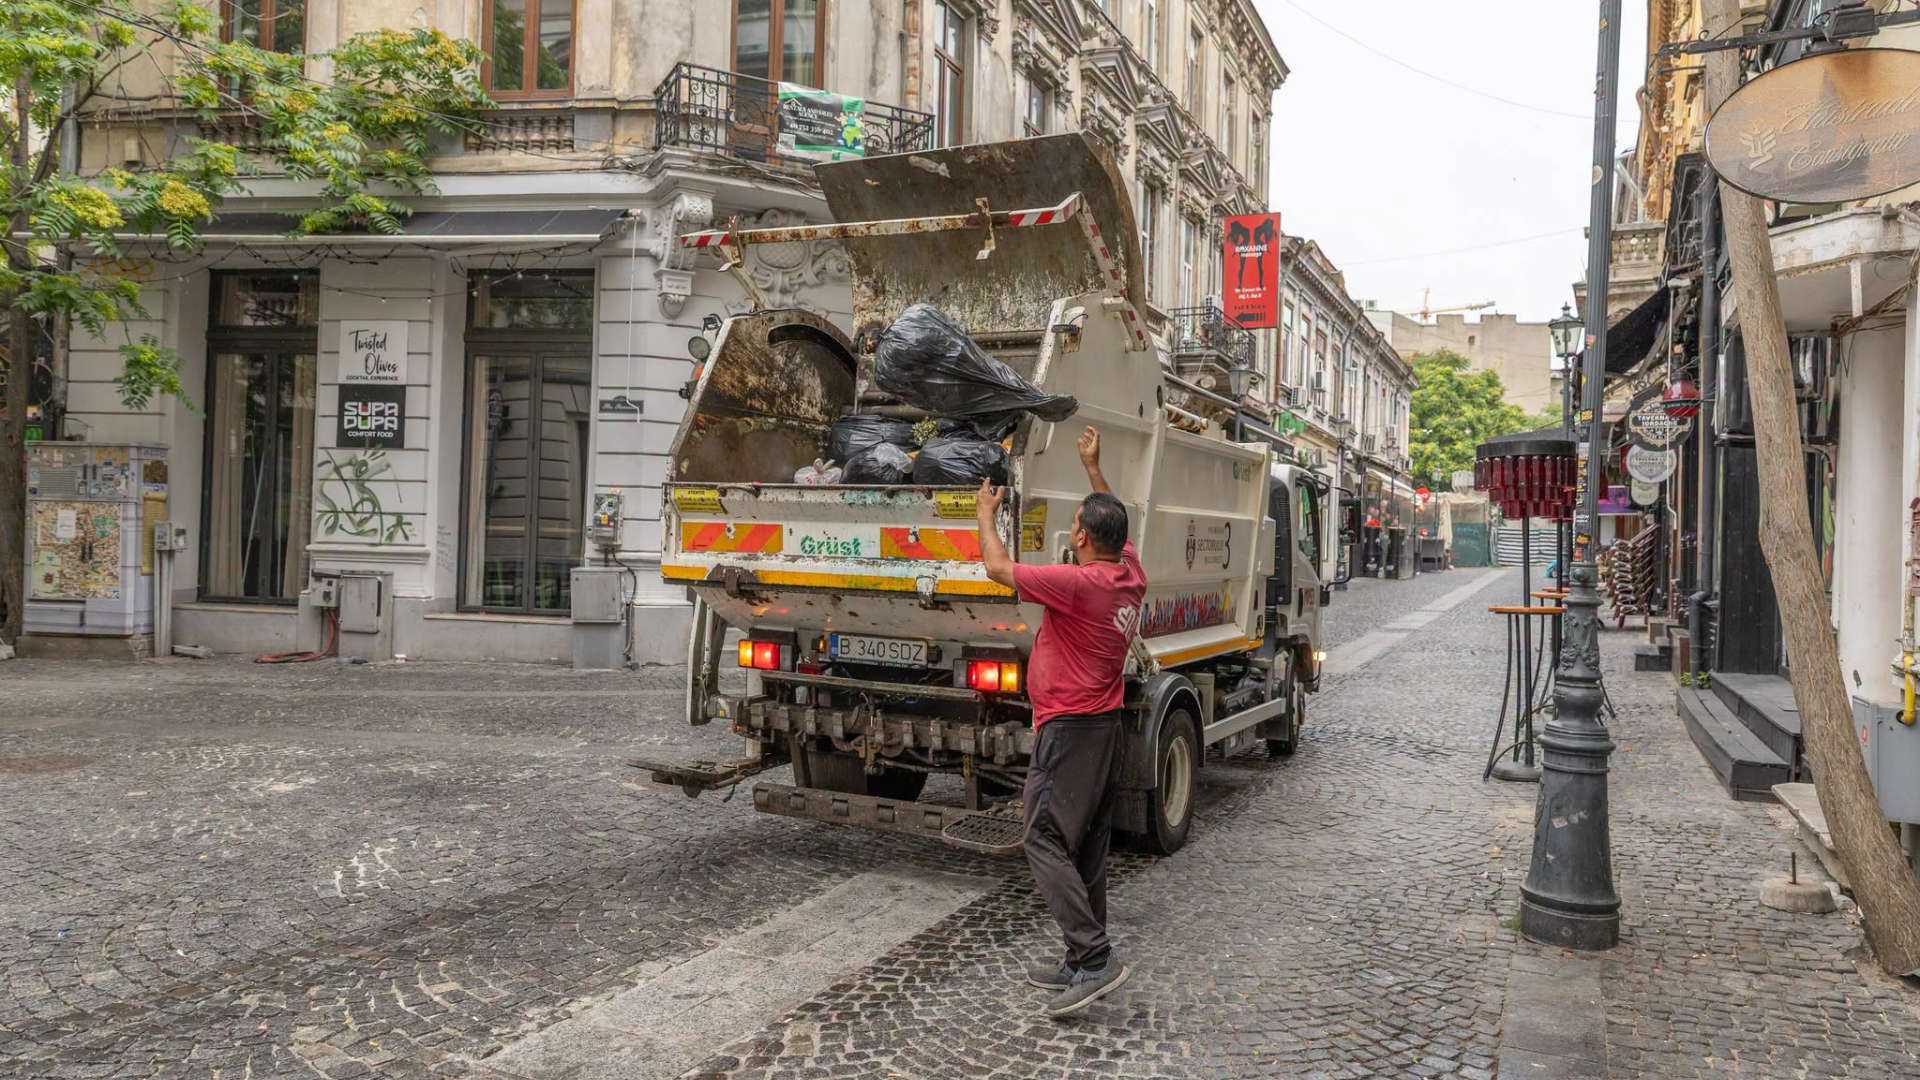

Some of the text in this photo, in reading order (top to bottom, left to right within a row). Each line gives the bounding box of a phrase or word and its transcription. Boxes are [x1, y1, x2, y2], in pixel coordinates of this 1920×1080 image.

[1235, 245, 1267, 253] ROXANNE
[348, 329, 388, 353] Twisted
[364, 353, 398, 375] Olives
[344, 401, 398, 416] SUPA
[344, 416, 398, 430] DUPA
[1233, 461, 1251, 481] Grüst
[800, 534, 861, 556] Grüst
[1197, 521, 1232, 570] SECTORULUI 3
[840, 638, 851, 655] B
[858, 639, 886, 658] 340
[889, 642, 923, 662] SDZ
